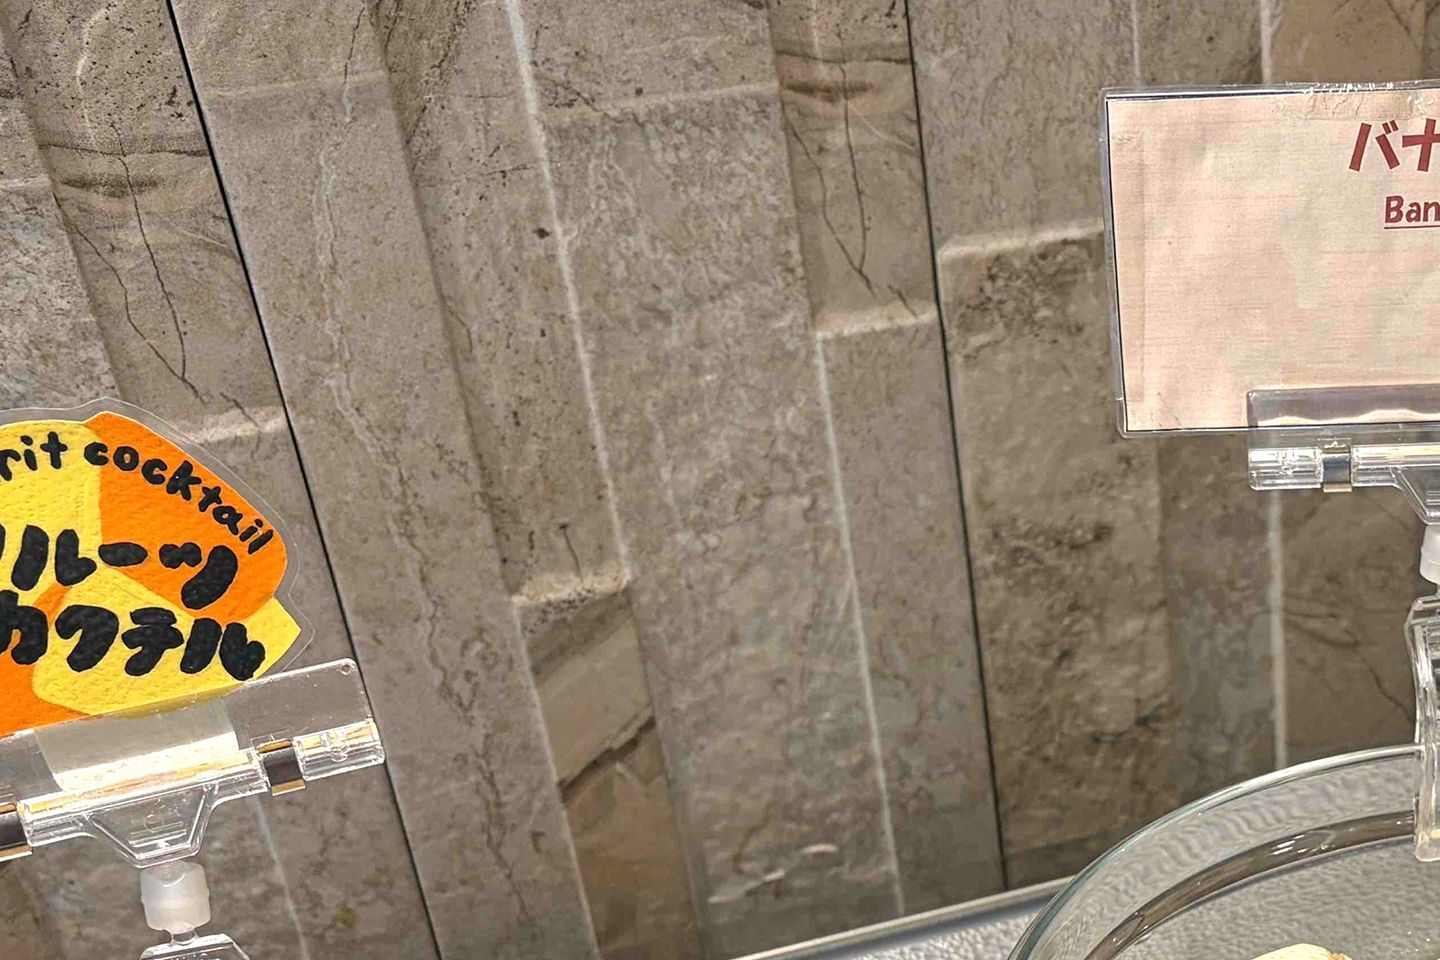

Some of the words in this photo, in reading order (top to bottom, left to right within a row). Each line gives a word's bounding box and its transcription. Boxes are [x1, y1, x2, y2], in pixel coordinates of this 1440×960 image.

[84, 441, 274, 555] cocktail
[0, 524, 239, 611] ルーツ
